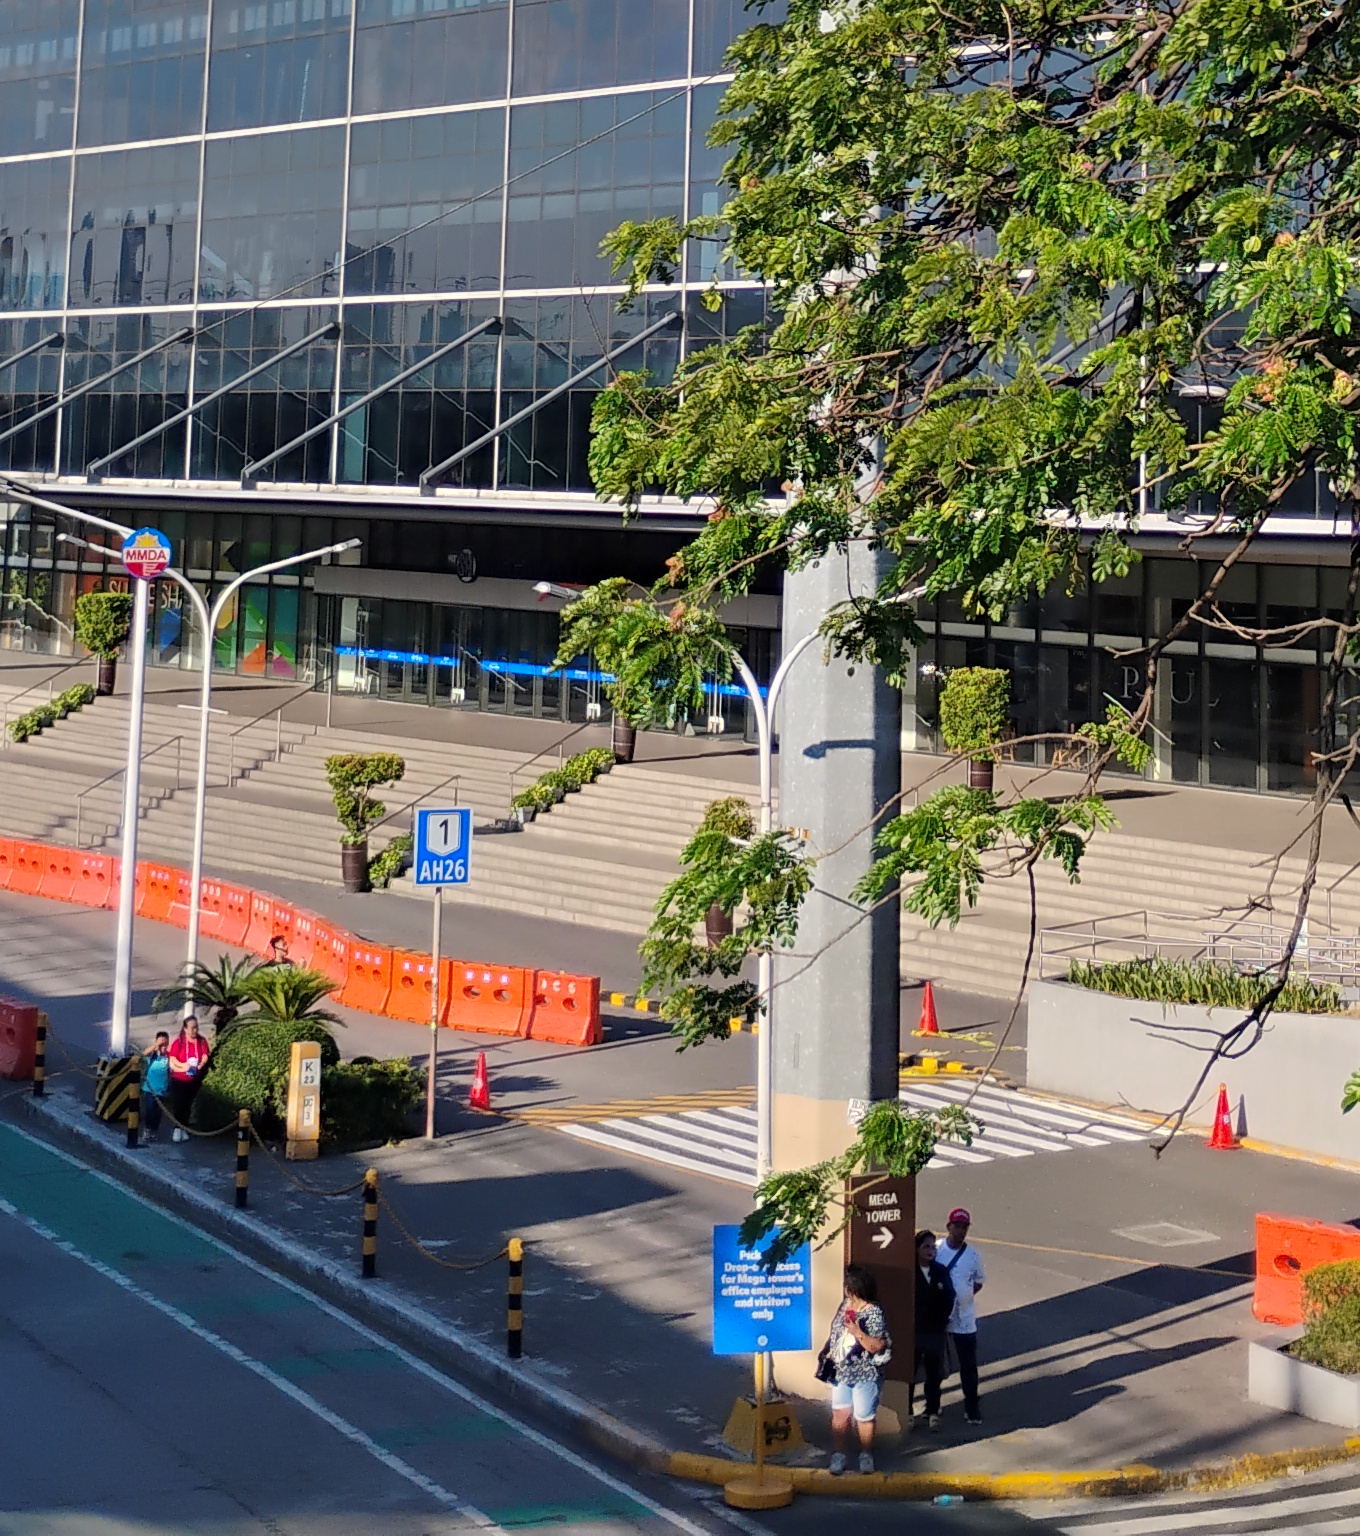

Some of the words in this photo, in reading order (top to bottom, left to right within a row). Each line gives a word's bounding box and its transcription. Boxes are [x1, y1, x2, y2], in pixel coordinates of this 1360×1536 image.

[125, 549, 167, 561] MMDA
[438, 818, 449, 846] 1
[418, 858, 466, 882] AH26
[305, 1062, 314, 1072] K
[303, 1075, 315, 1084] 23
[868, 1192, 899, 1207] MEGA
[865, 1208, 902, 1225] TOWER
[721, 1274, 736, 1284] for
[737, 1274, 766, 1285] Mega
[721, 1286, 750, 1296] office
[751, 1285, 805, 1296] employees
[734, 1297, 754, 1308] and
[754, 1296, 791, 1307] visitors
[751, 1308, 774, 1322] only
